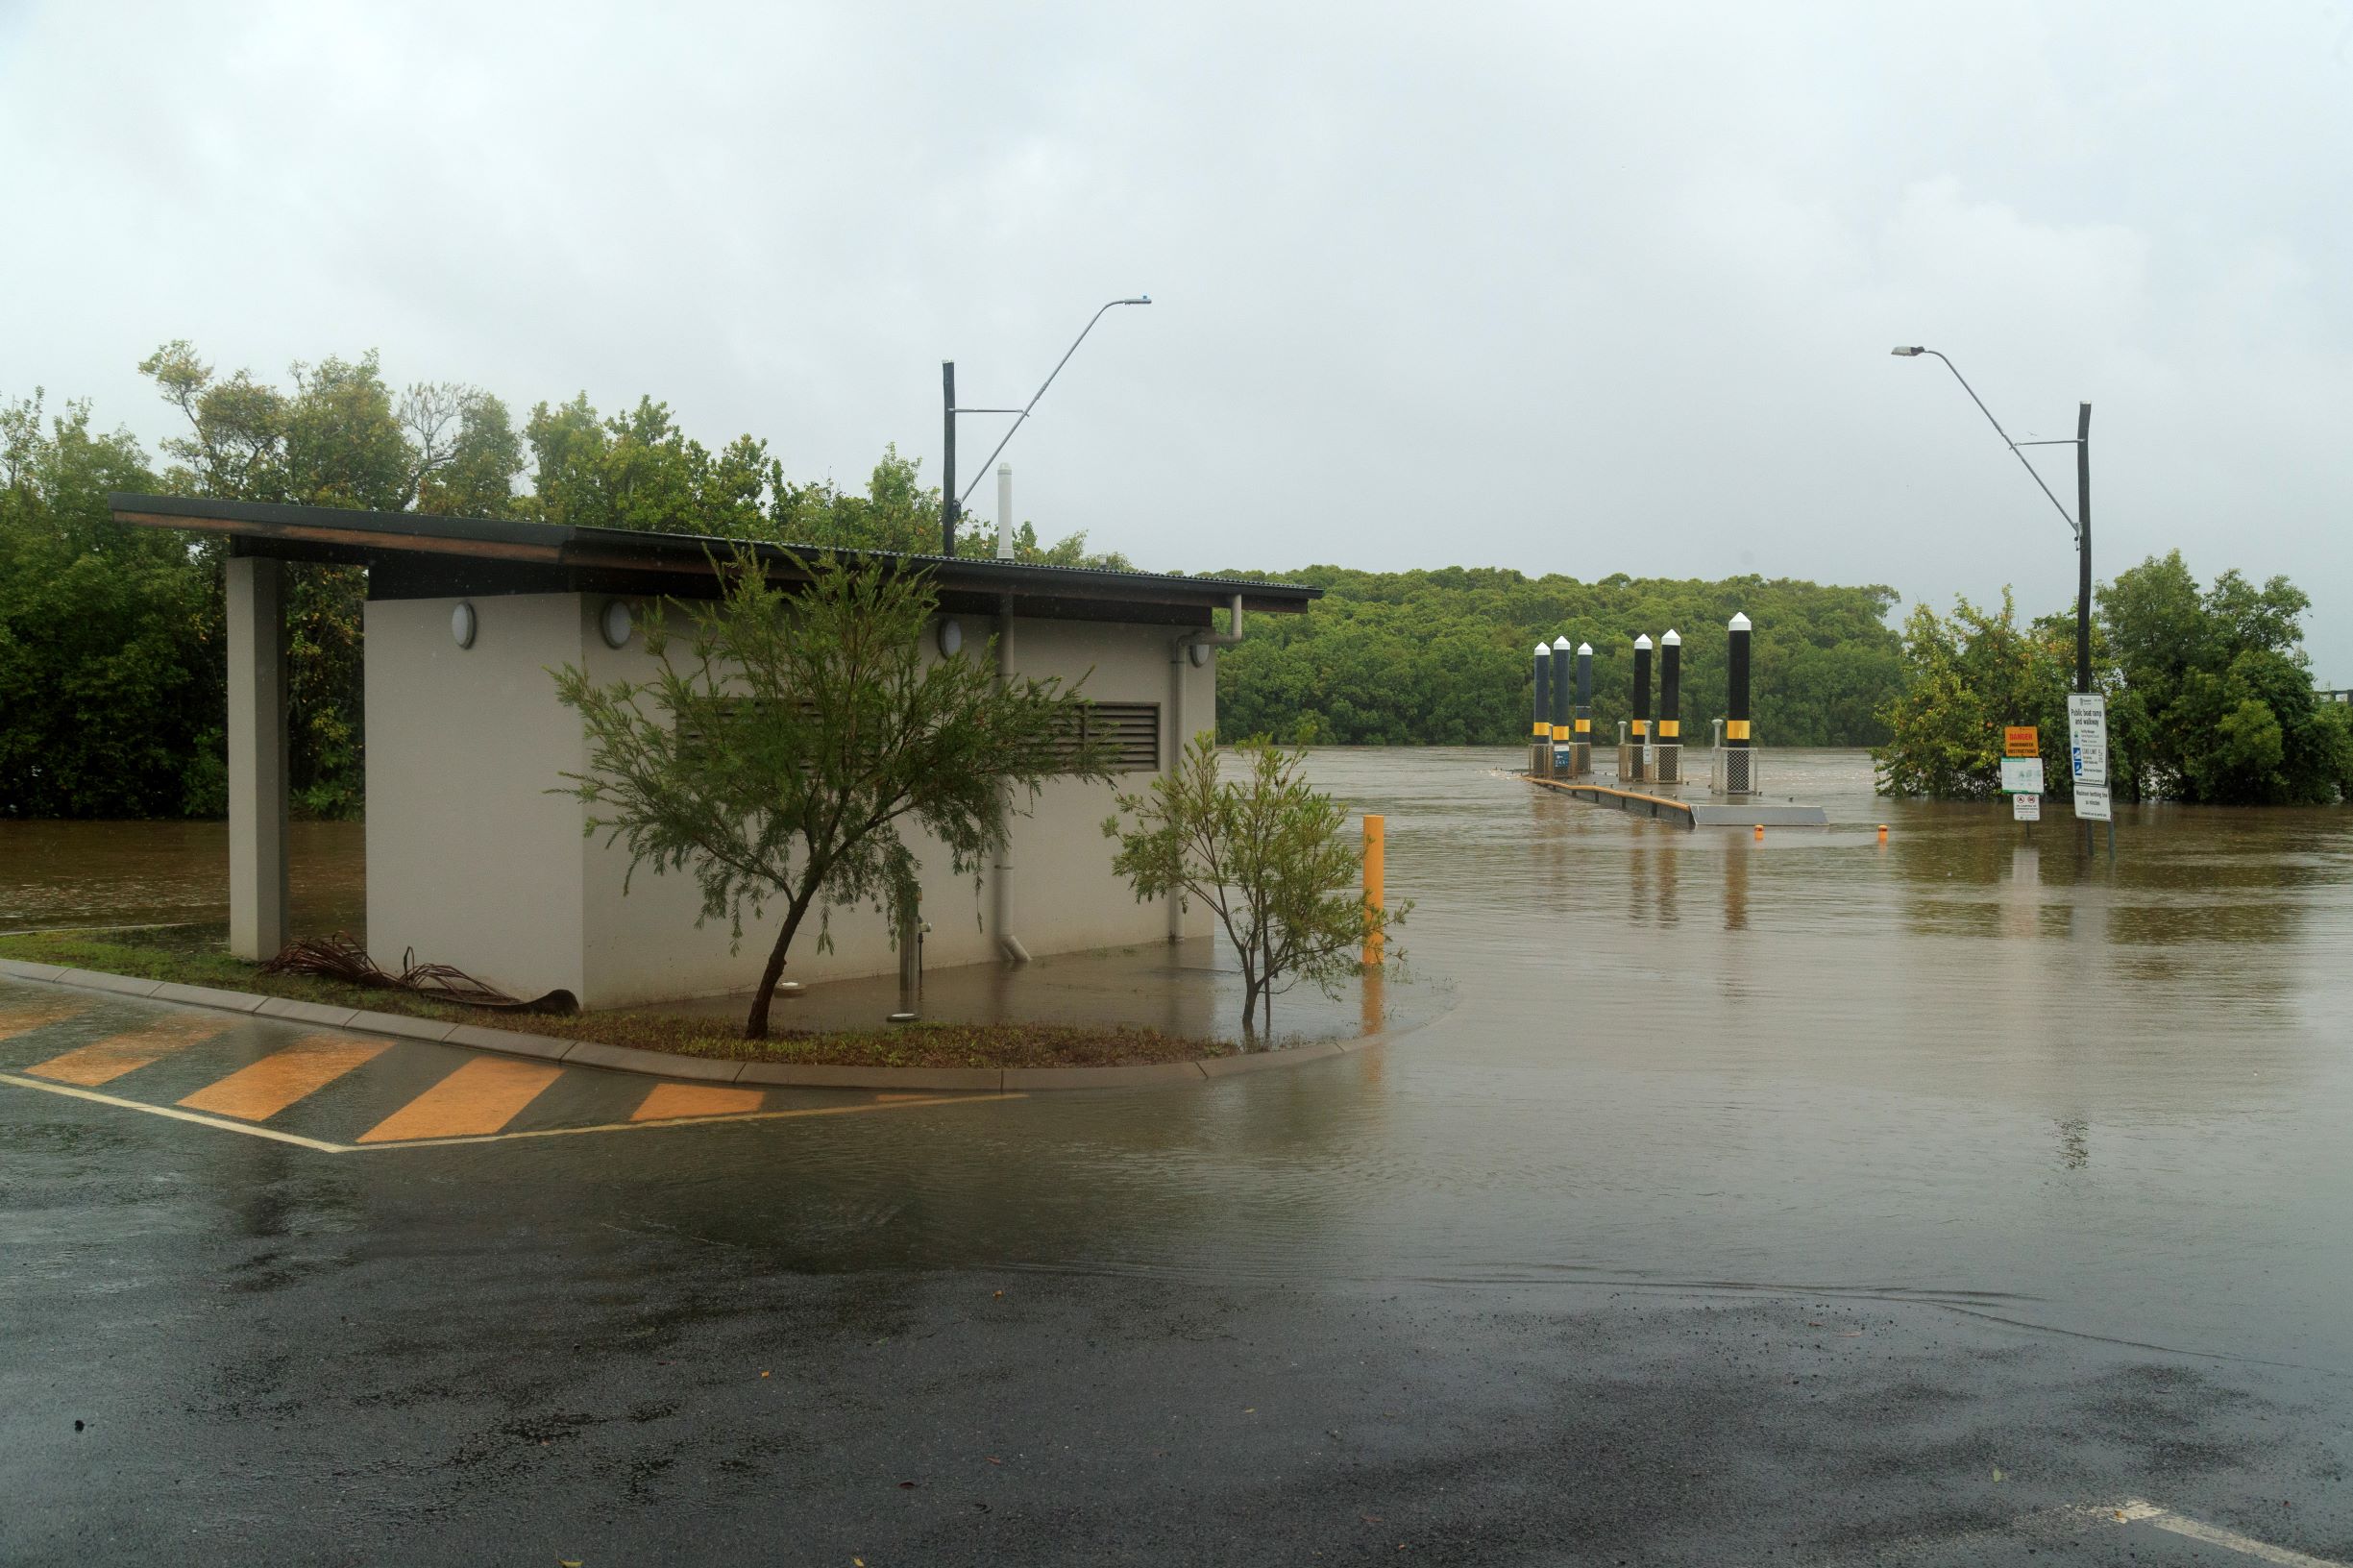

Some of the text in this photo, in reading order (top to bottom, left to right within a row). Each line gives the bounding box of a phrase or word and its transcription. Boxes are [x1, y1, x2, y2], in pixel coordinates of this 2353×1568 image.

[2071, 708, 2102, 720] Public boat ramp
[2083, 718, 2099, 727] walkway
